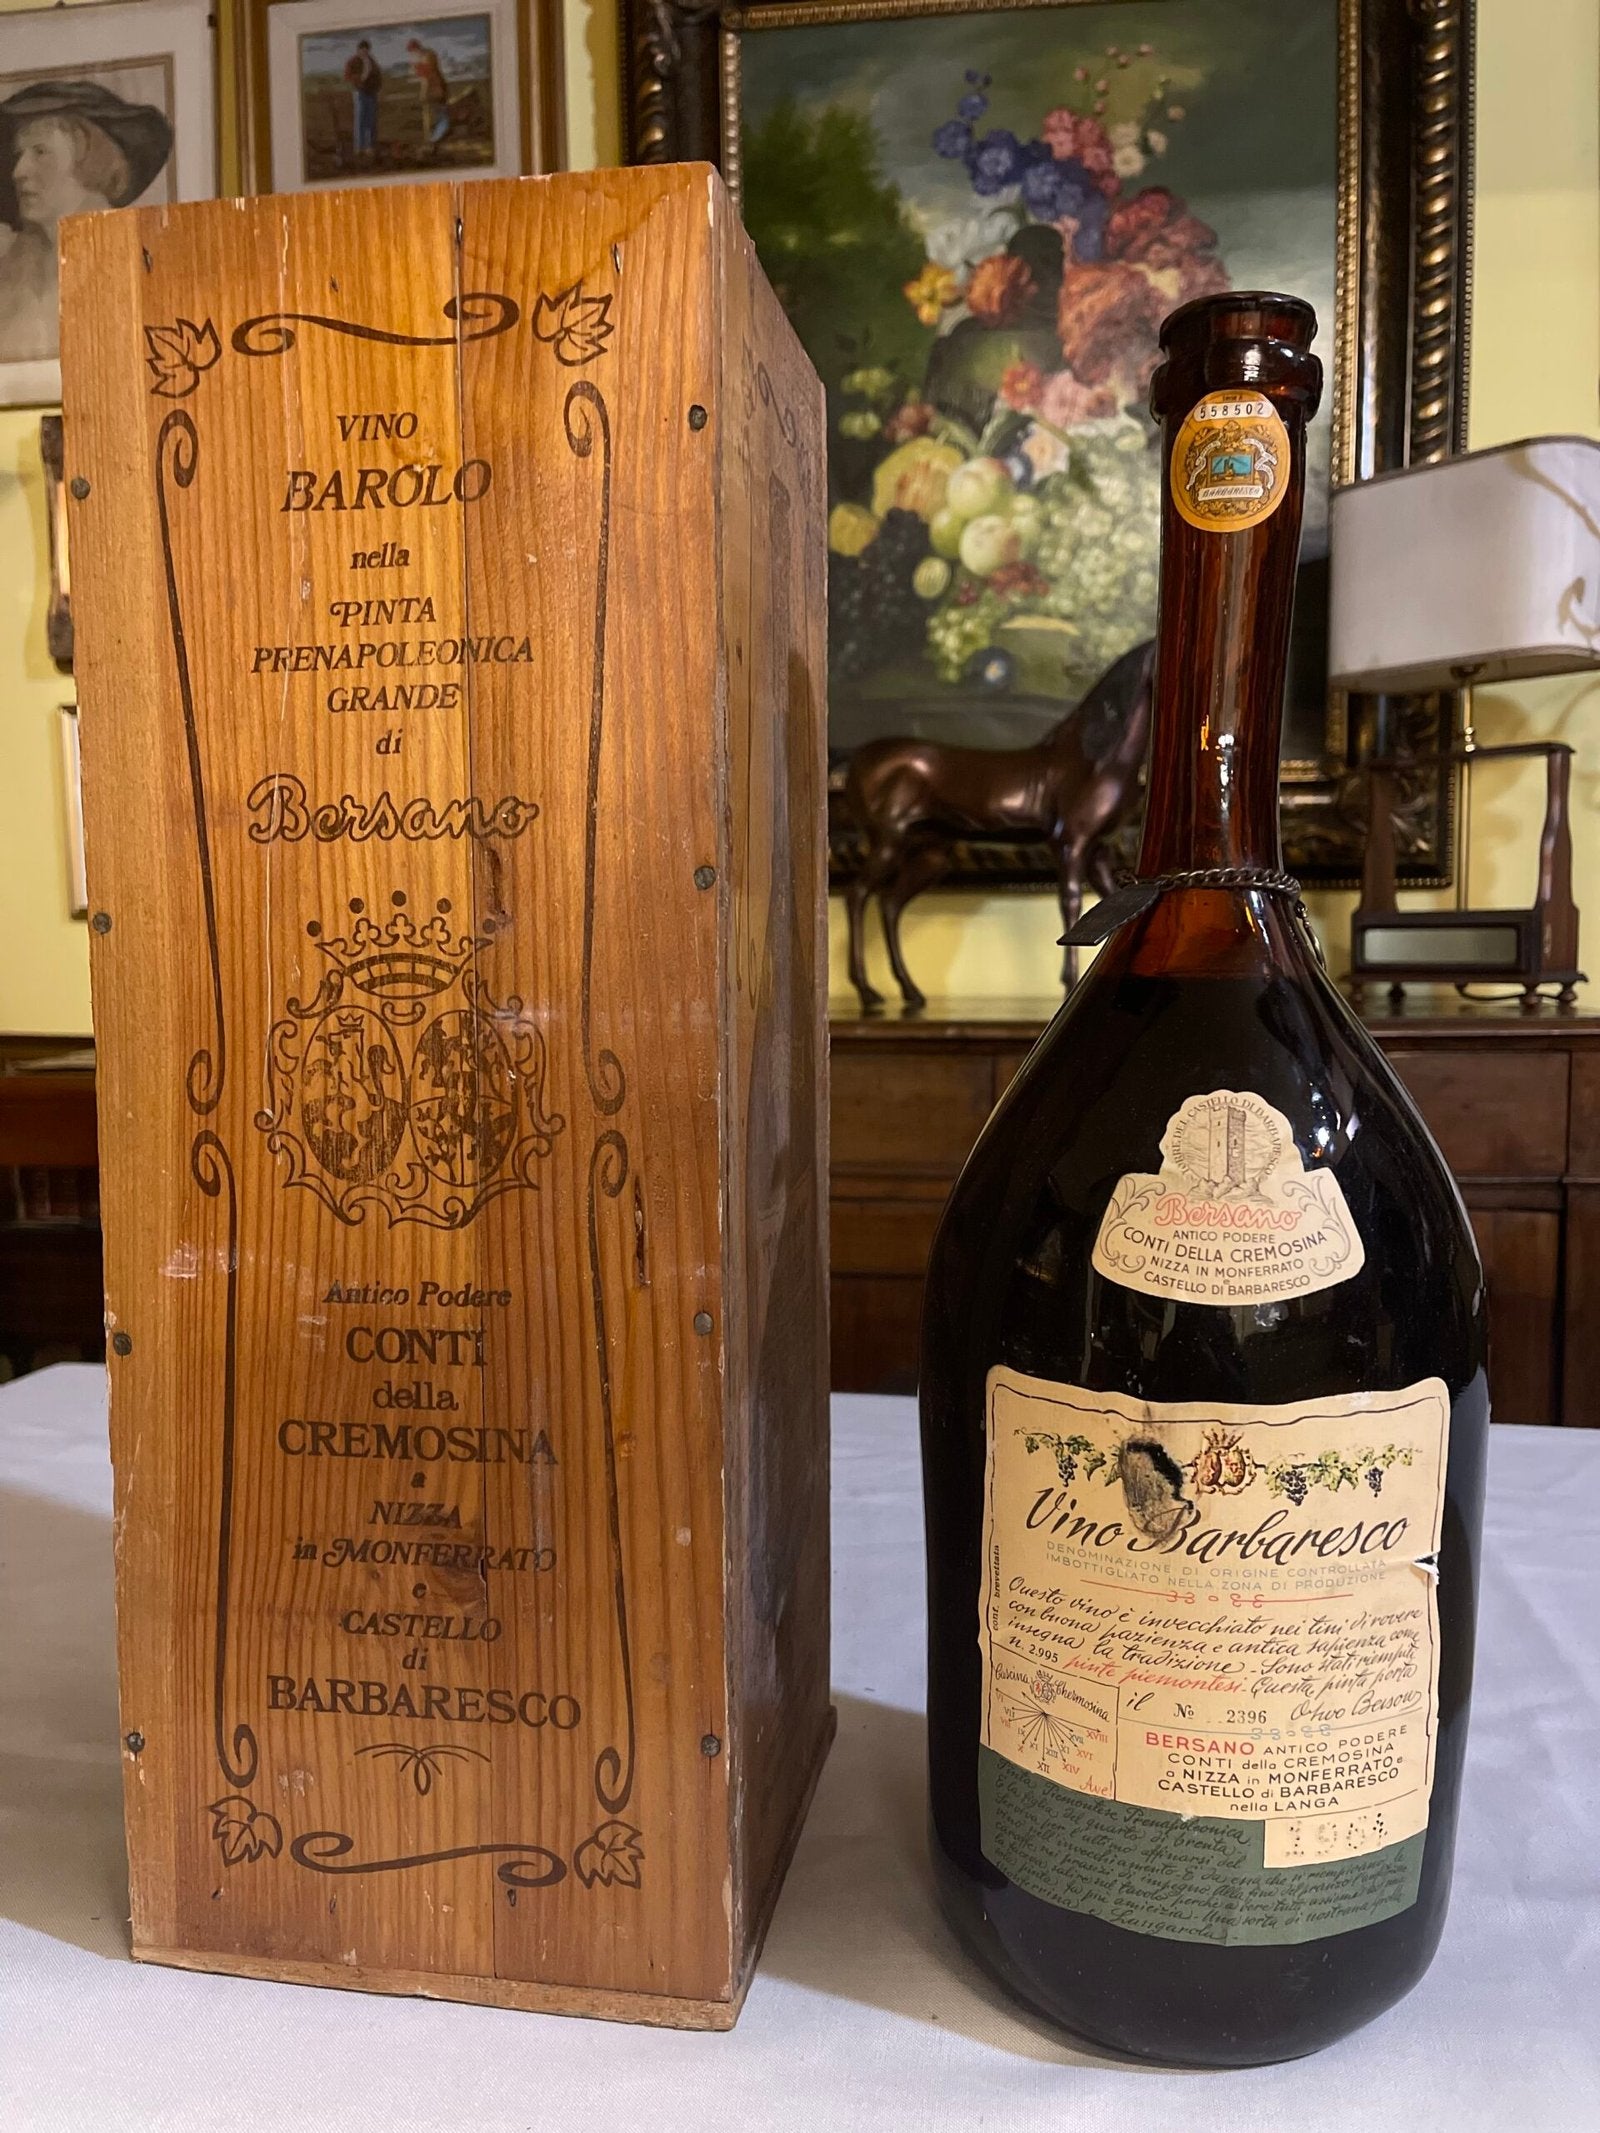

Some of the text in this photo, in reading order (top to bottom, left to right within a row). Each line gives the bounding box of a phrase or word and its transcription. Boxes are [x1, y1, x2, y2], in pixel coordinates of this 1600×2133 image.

[336, 411, 418, 442] VINO
[1199, 402, 1265, 420] 558502
[280, 458, 493, 512] BAROLO
[350, 542, 410, 569] nella
[329, 597, 436, 628] PINTA
[251, 636, 535, 673] PRENAPOLEONICA
[327, 683, 463, 713] GRANDE
[375, 729, 404, 755] di
[247, 773, 540, 843] Bersano
[1154, 1192, 1301, 1230] Bersano
[1123, 1226, 1327, 1263] CONTI DELLA CREMOSINA
[1172, 1230, 1276, 1244] ANTICO PODERE
[1150, 1255, 1304, 1278] NIZZA IN MONFERRATO
[322, 1279, 513, 1308] Antico Podere
[1144, 1271, 1311, 1296] CASTELLO DI BARBARESCO
[345, 1326, 488, 1366] CONTI
[372, 1381, 460, 1411] della
[278, 1419, 559, 1466] CREMOSINA
[410, 1471, 426, 1488] a
[368, 1501, 462, 1530] NIZZA
[1026, 1487, 1411, 1566] Vino Barbaresco
[292, 1536, 558, 1573] in MONFERRATO
[1047, 1541, 1387, 1578] DENOMINAZIONE DI ORIGINE CONTROLLATA
[1046, 1552, 1387, 1591] IMBOTTIGLIATO NELLA ZONA DI PRODUZIONE
[412, 1583, 427, 1599] e
[1008, 1576, 1068, 1606] Questo
[1069, 1598, 1120, 1619] vino
[1139, 1610, 1273, 1637] invecchiato
[1270, 1619, 1305, 1636] nei
[342, 1610, 501, 1643] CASTELLO
[1008, 1601, 1037, 1617] con
[1040, 1607, 1101, 1634] buona
[1099, 1624, 1208, 1654] pazienza
[1228, 1638, 1300, 1657] antica
[401, 1648, 429, 1671] di
[1007, 1617, 1084, 1649] insegna
[1092, 1640, 1116, 1660] la
[1121, 1644, 1245, 1674] tradizione
[1008, 1634, 1025, 1650] n.
[1028, 1643, 1059, 1663] 2.995
[267, 1674, 582, 1731] BARBARESCO
[1126, 1691, 1155, 1712] il
[1226, 1710, 1268, 1725] 2396
[1146, 1725, 1408, 1756] BERSANO ANTICO PODERE
[1168, 1742, 1394, 1770] CONTI della CREMOSINA
[1158, 1767, 1399, 1799] CASTELLO di BARBARESCO
[1183, 1769, 1240, 1785] NIZZA
[1247, 1775, 1260, 1785] in
[1269, 1756, 1393, 1784] MONFERRATO
[1230, 1797, 1339, 1812] nella LANGA
